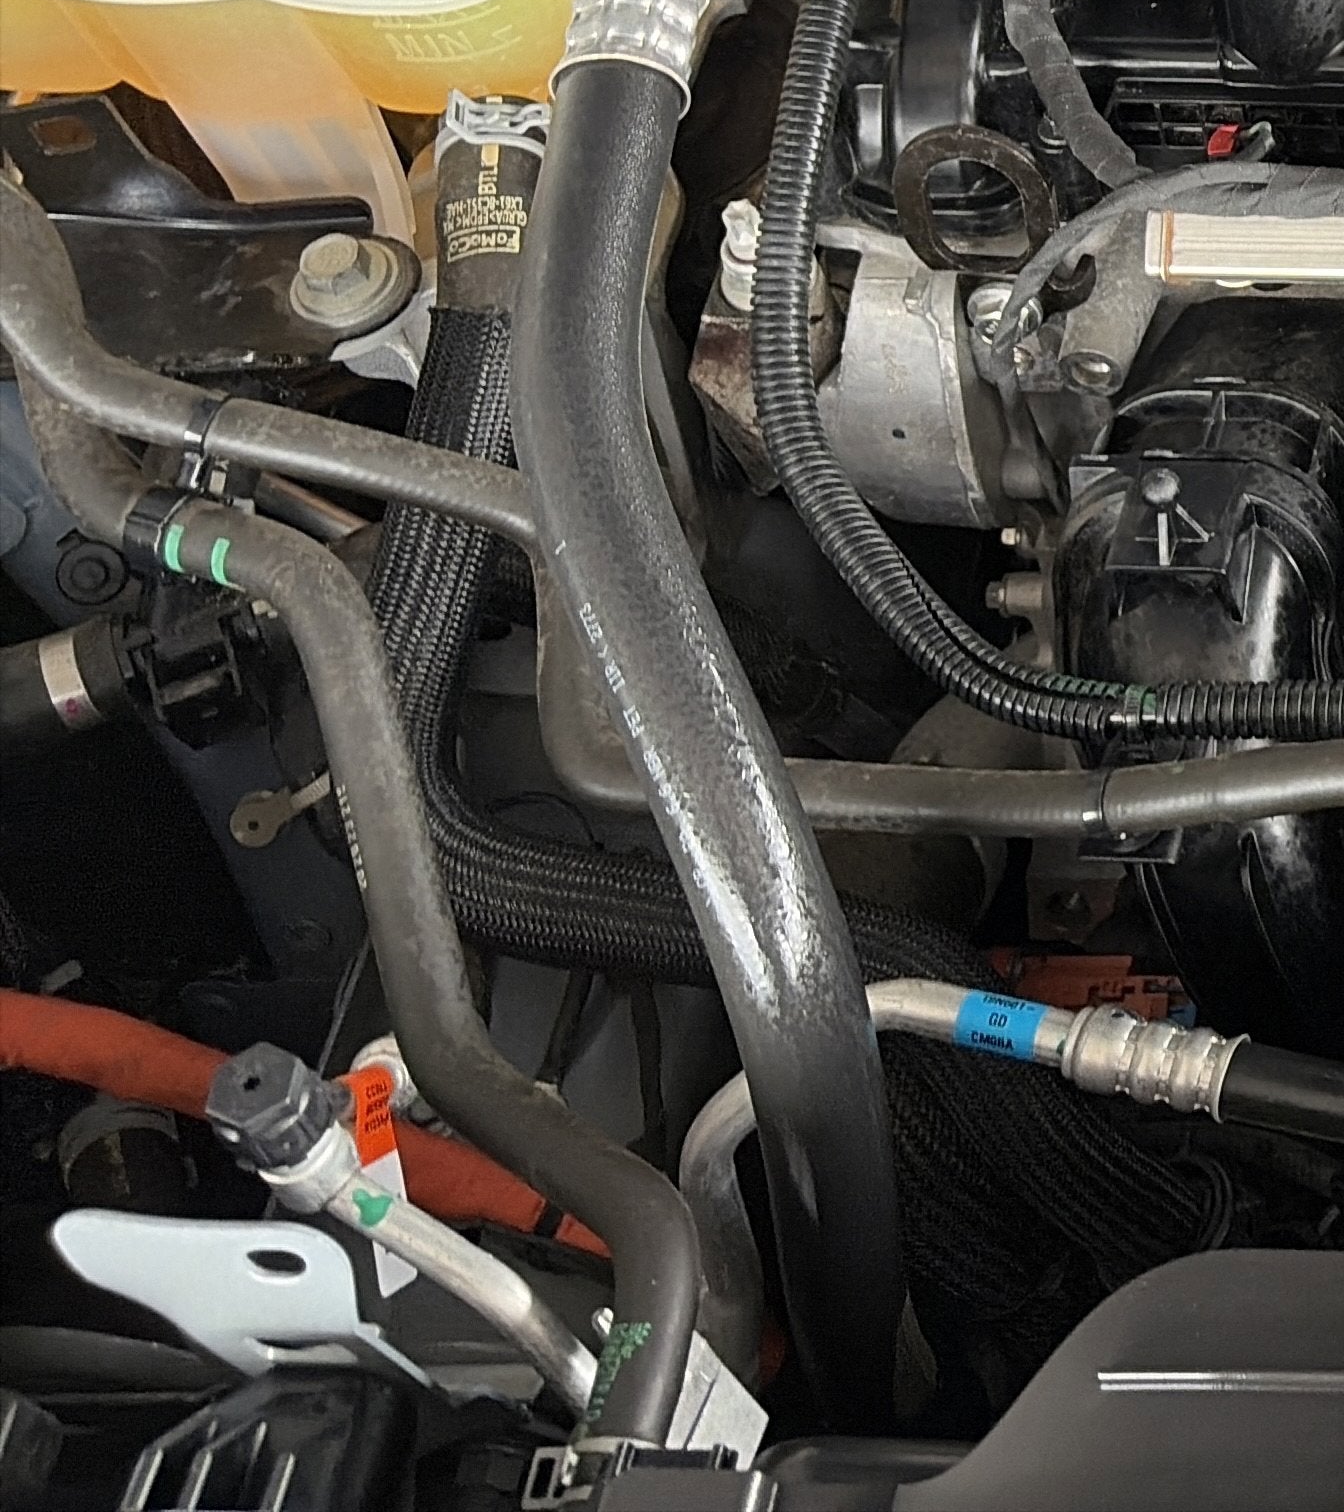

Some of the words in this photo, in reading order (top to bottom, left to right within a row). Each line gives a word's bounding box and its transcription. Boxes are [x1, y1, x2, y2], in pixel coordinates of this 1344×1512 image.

[385, 30, 475, 61] MIN
[477, 165, 498, 197] BTL
[450, 232, 517, 253] FoMoCo
